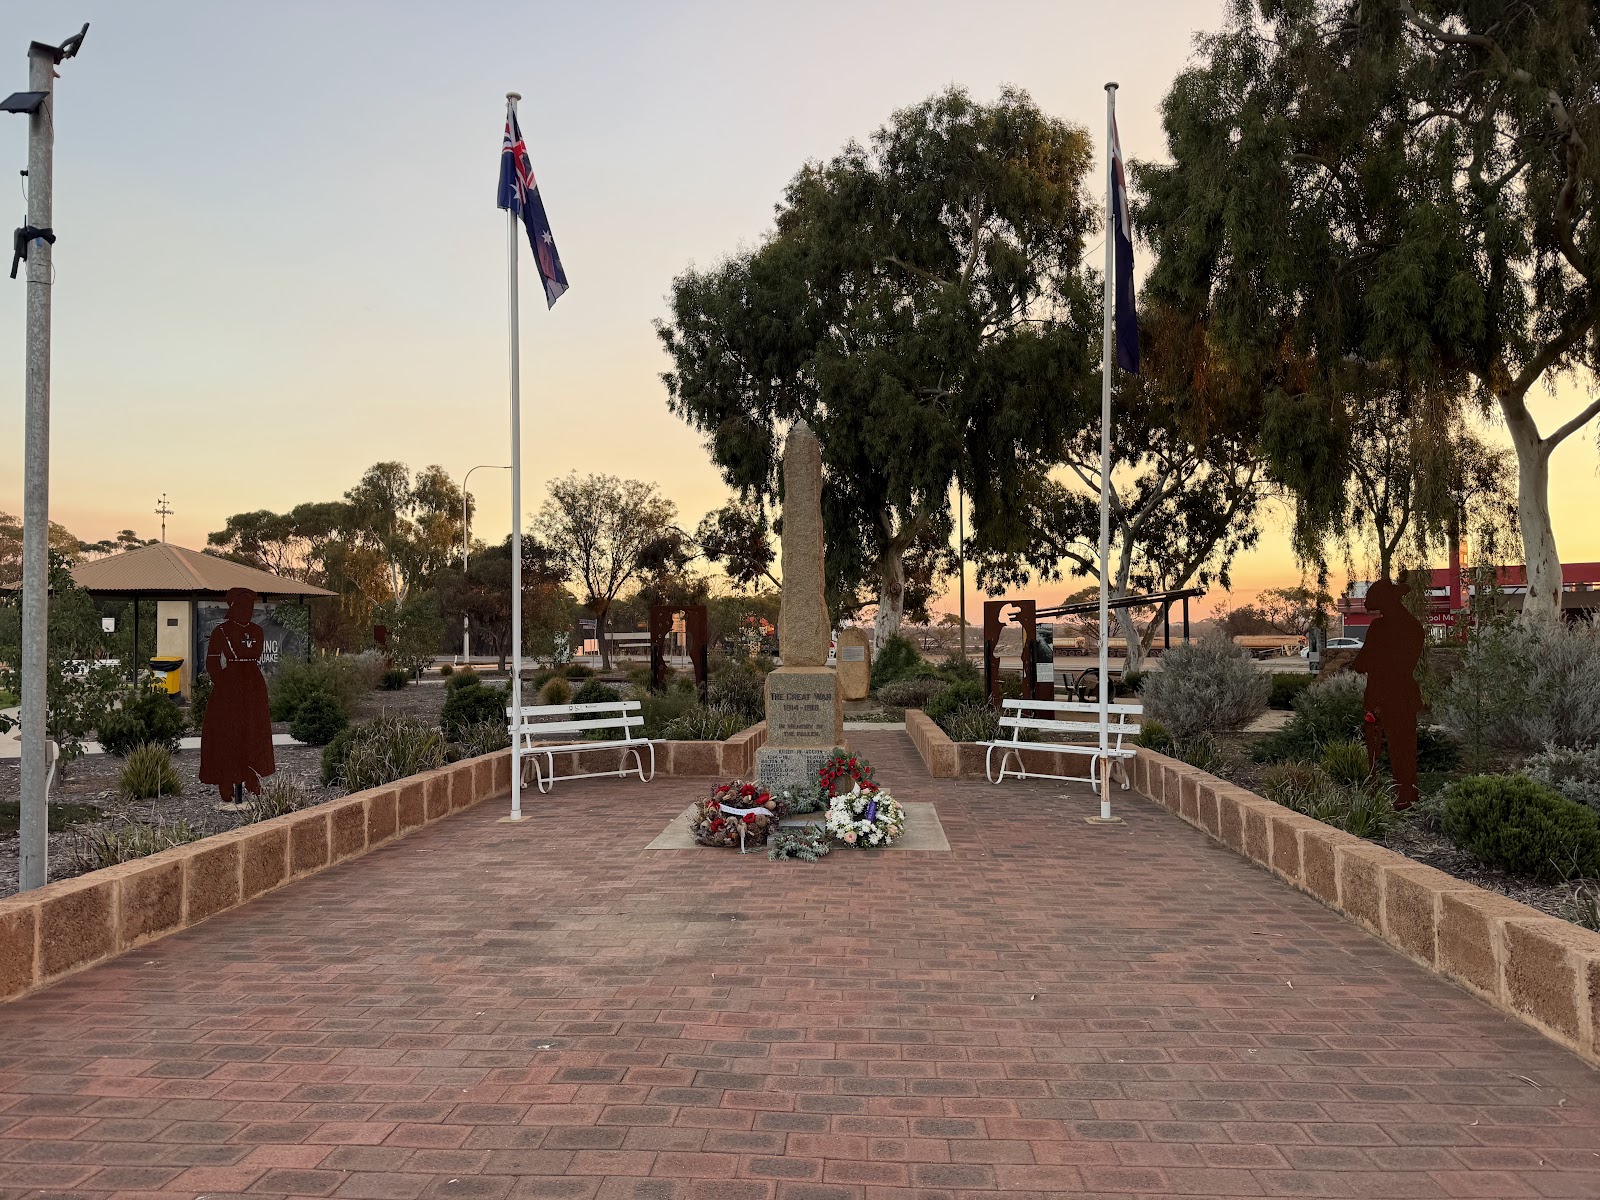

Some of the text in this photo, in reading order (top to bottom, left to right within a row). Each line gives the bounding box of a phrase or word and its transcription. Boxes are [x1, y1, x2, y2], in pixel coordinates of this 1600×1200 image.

[263, 640, 278, 653] ING
[770, 692, 832, 701] THE GREAT WAR
